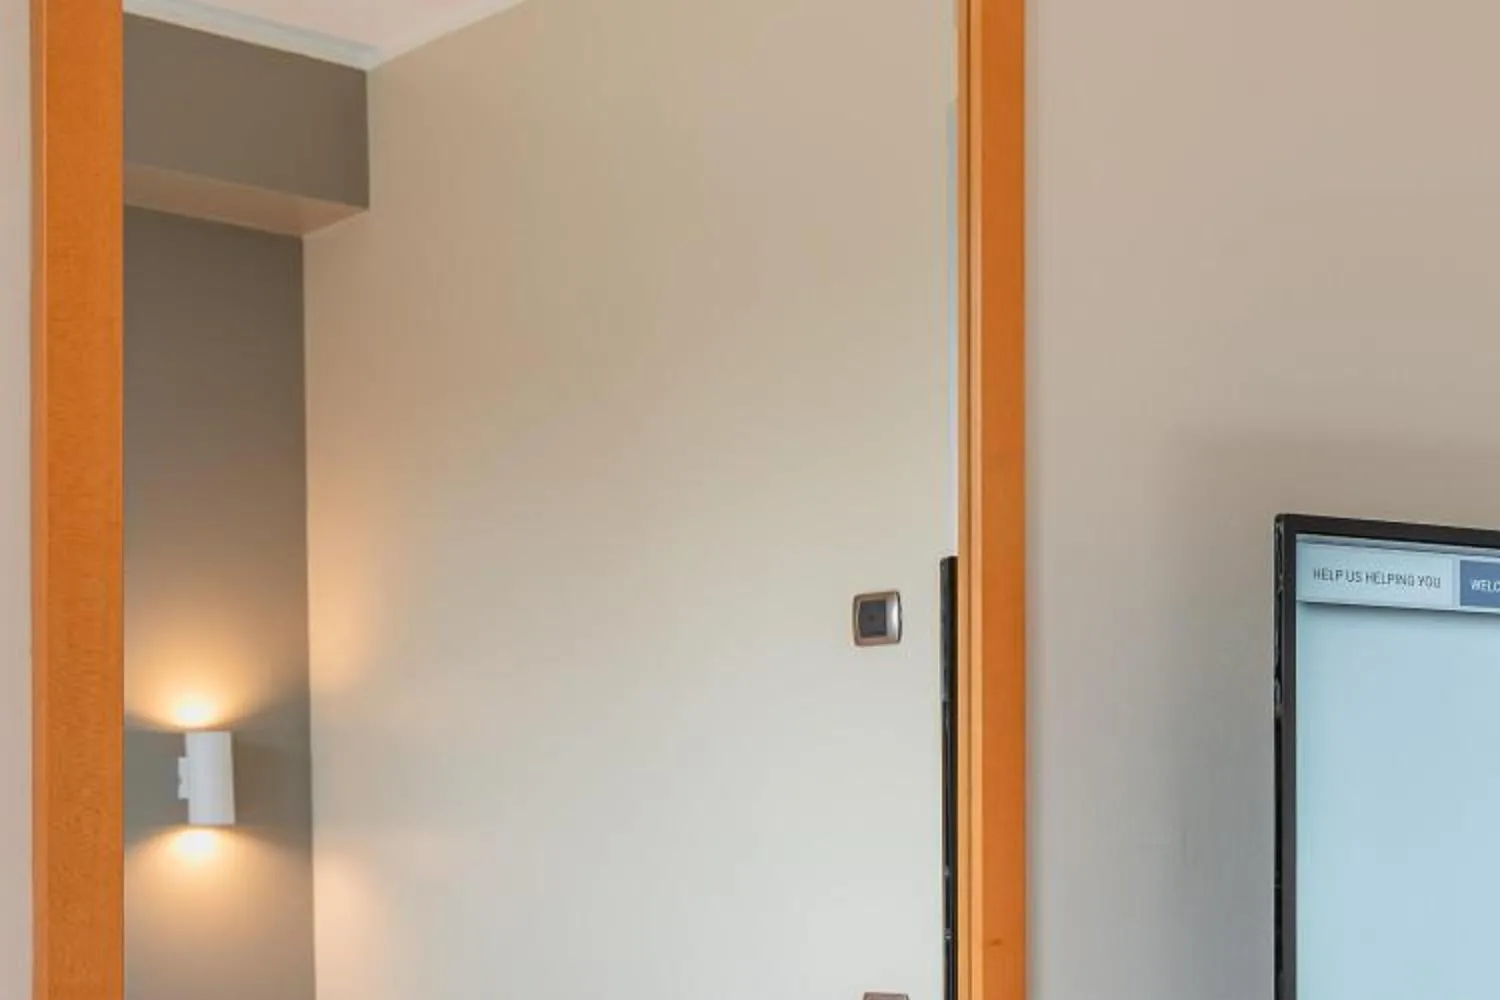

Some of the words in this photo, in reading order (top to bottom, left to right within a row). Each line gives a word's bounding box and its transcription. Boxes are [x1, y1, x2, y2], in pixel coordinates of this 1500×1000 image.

[1313, 567, 1343, 582] HELP
[1345, 570, 1363, 583] US
[1365, 571, 1415, 587] HELPING
[1417, 576, 1441, 589] YOU
